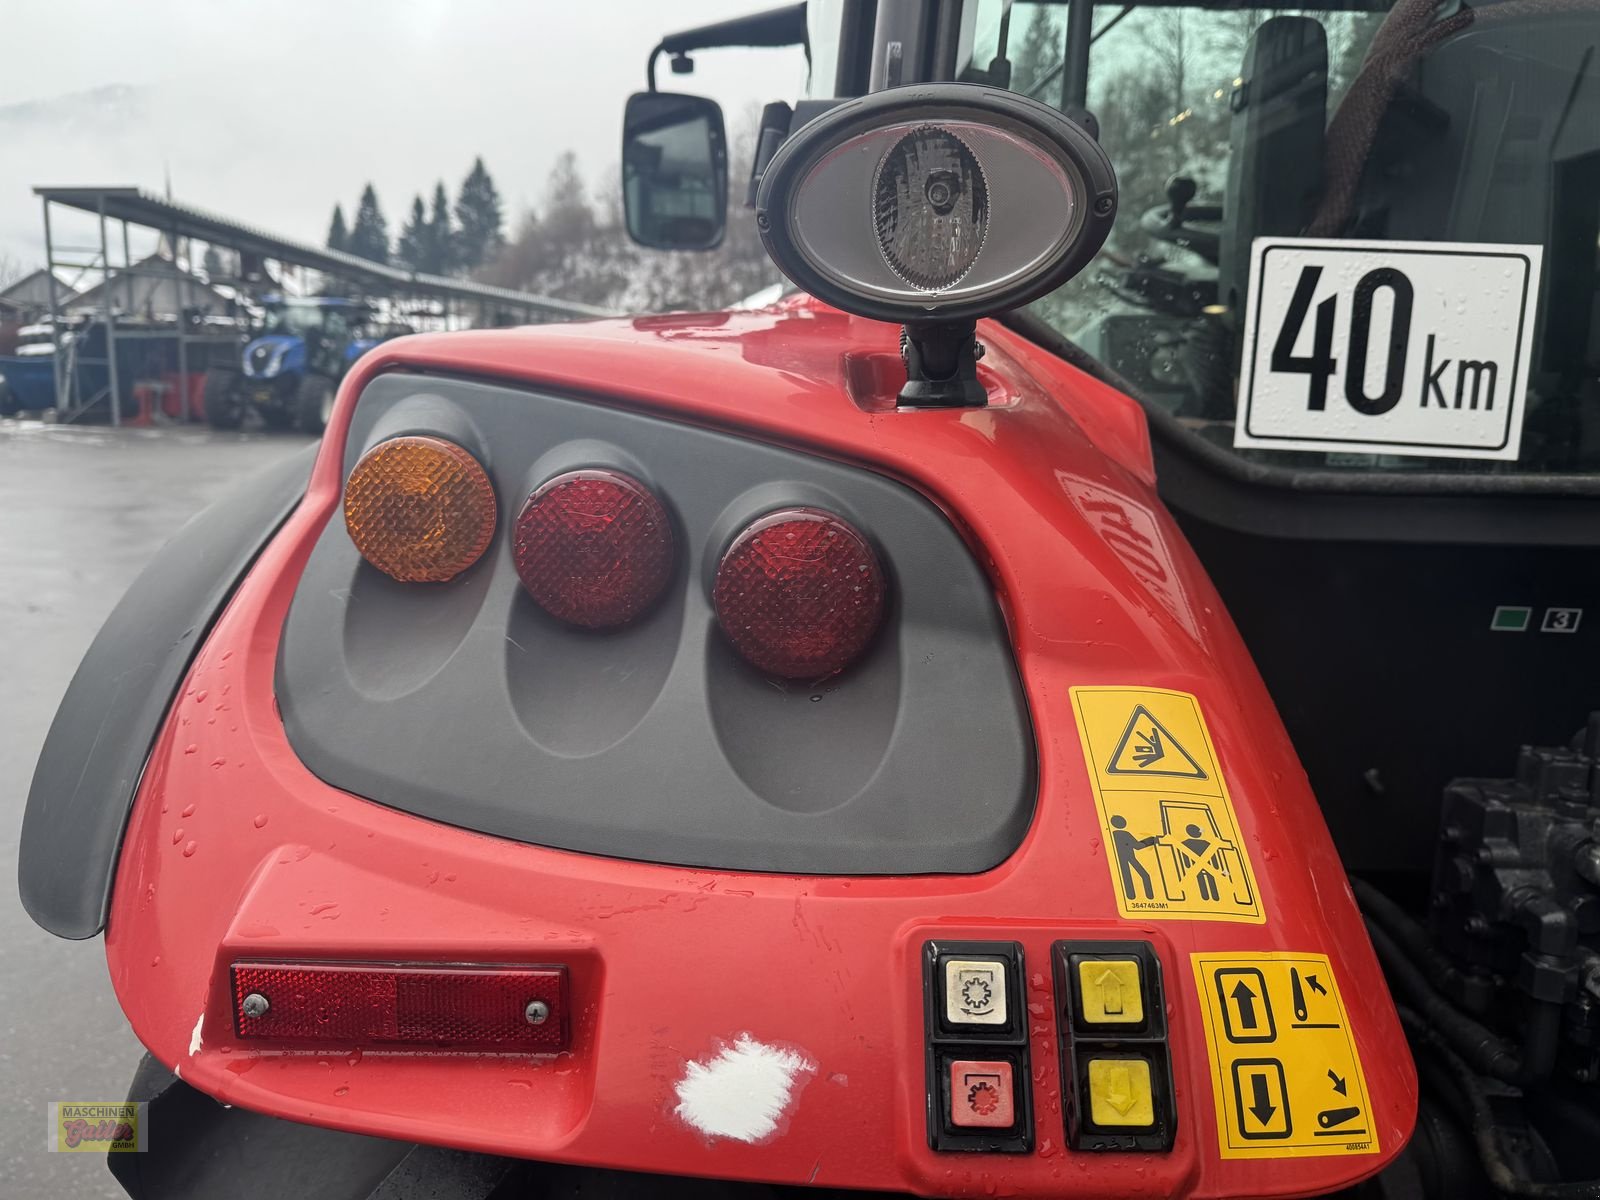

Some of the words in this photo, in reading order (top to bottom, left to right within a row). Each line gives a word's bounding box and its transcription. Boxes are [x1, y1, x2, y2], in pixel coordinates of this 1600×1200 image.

[1270, 266, 1414, 416] 40
[1419, 334, 1498, 411] km
[1553, 611, 1570, 629] 3
